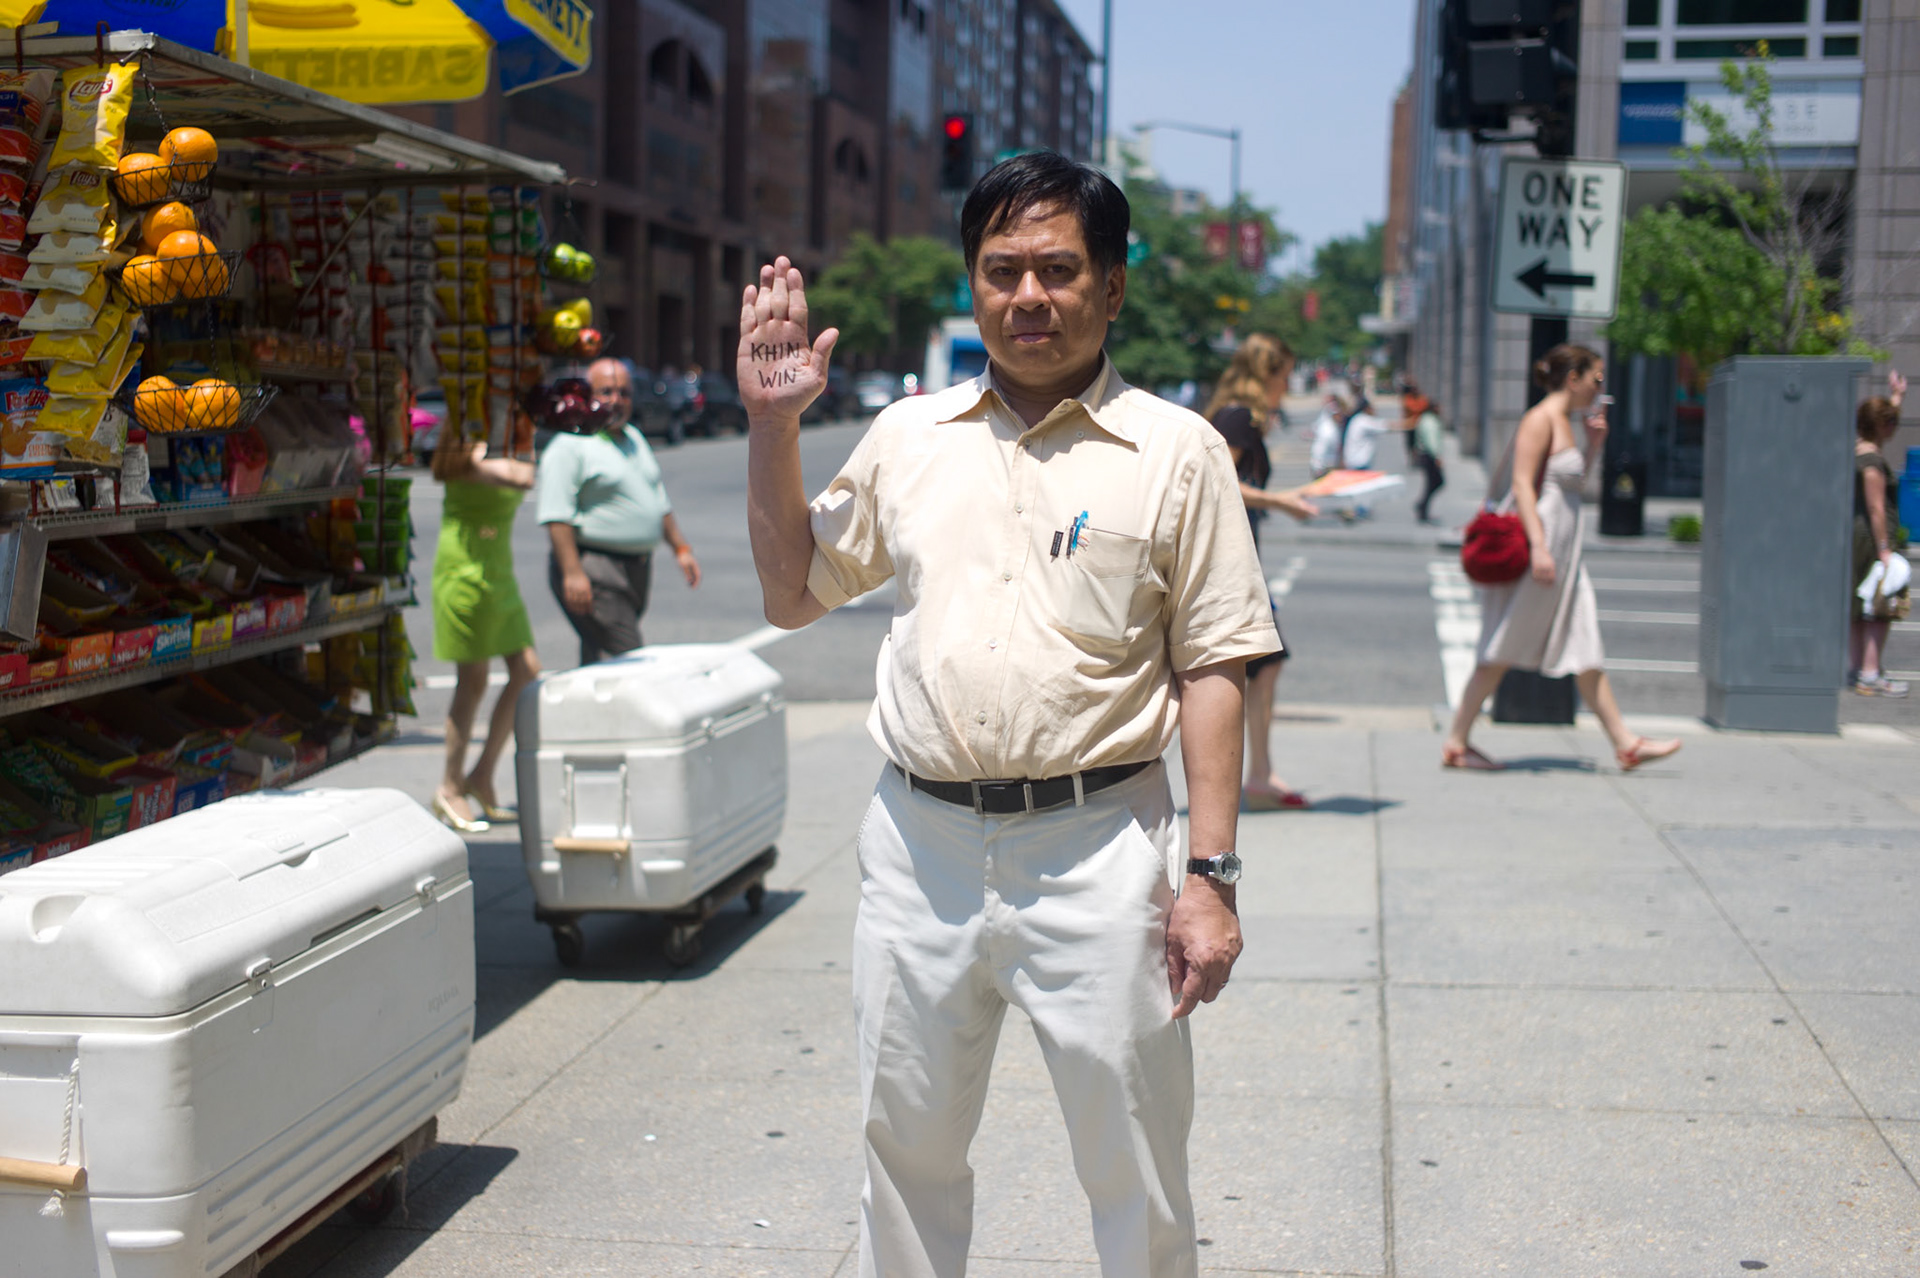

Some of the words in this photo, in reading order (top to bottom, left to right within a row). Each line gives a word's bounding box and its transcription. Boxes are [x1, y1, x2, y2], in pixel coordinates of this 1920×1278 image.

[1523, 171, 1602, 209] ONE
[1518, 212, 1603, 250] WAY
[750, 342, 800, 362] KHIN
[758, 368, 796, 388] WIN
[5, 388, 50, 412] Ruffle
